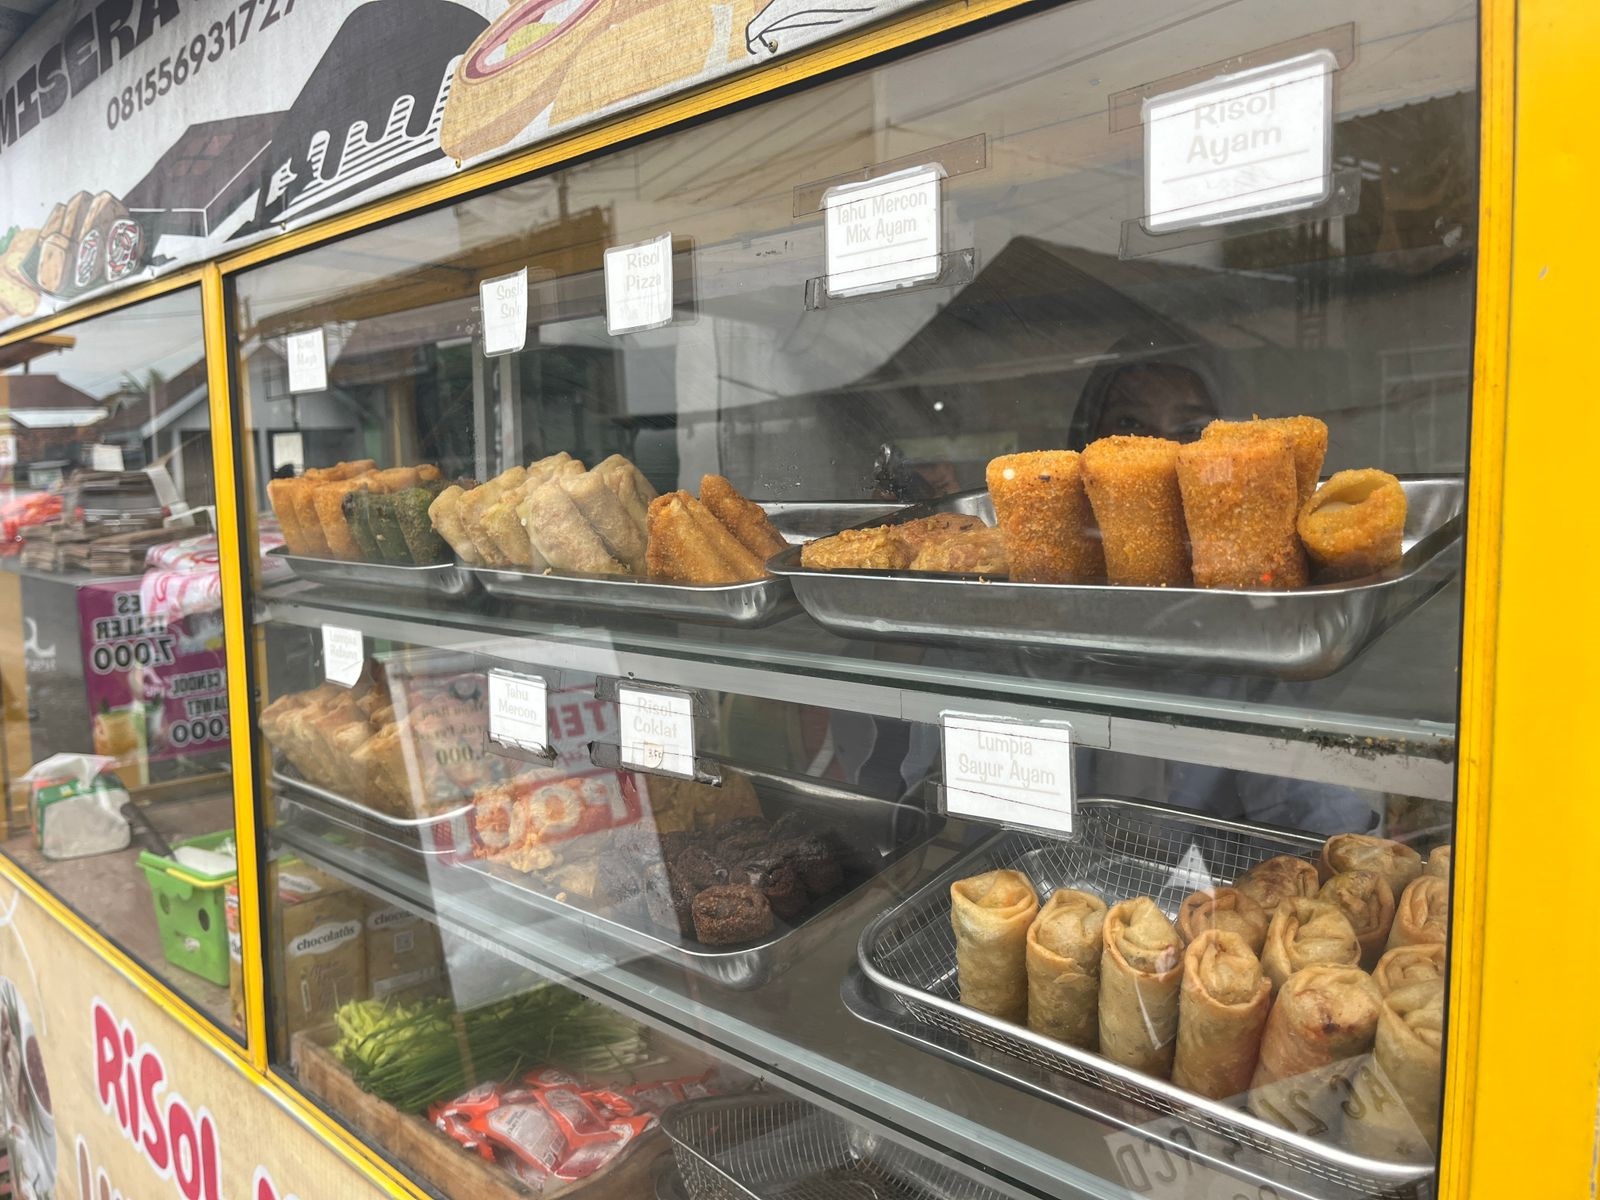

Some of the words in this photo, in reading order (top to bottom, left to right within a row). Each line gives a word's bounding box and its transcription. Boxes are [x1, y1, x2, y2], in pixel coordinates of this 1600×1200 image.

[1193, 84, 1277, 130] Risol
[1186, 123, 1282, 167] Ayam
[833, 204, 864, 225] Tahu
[870, 190, 926, 217] Mercon
[844, 225, 870, 246] Mix
[873, 218, 916, 242] Ayam
[626, 245, 660, 271] Risol
[625, 273, 662, 292] Pizza
[505, 682, 528, 701] Tahu
[498, 698, 537, 721] Mercon
[637, 696, 673, 718] Risol
[633, 715, 678, 740] Coklat
[977, 731, 1033, 756] Lumpia
[958, 753, 1003, 784] Sayur
[1009, 764, 1056, 790] Ayam
